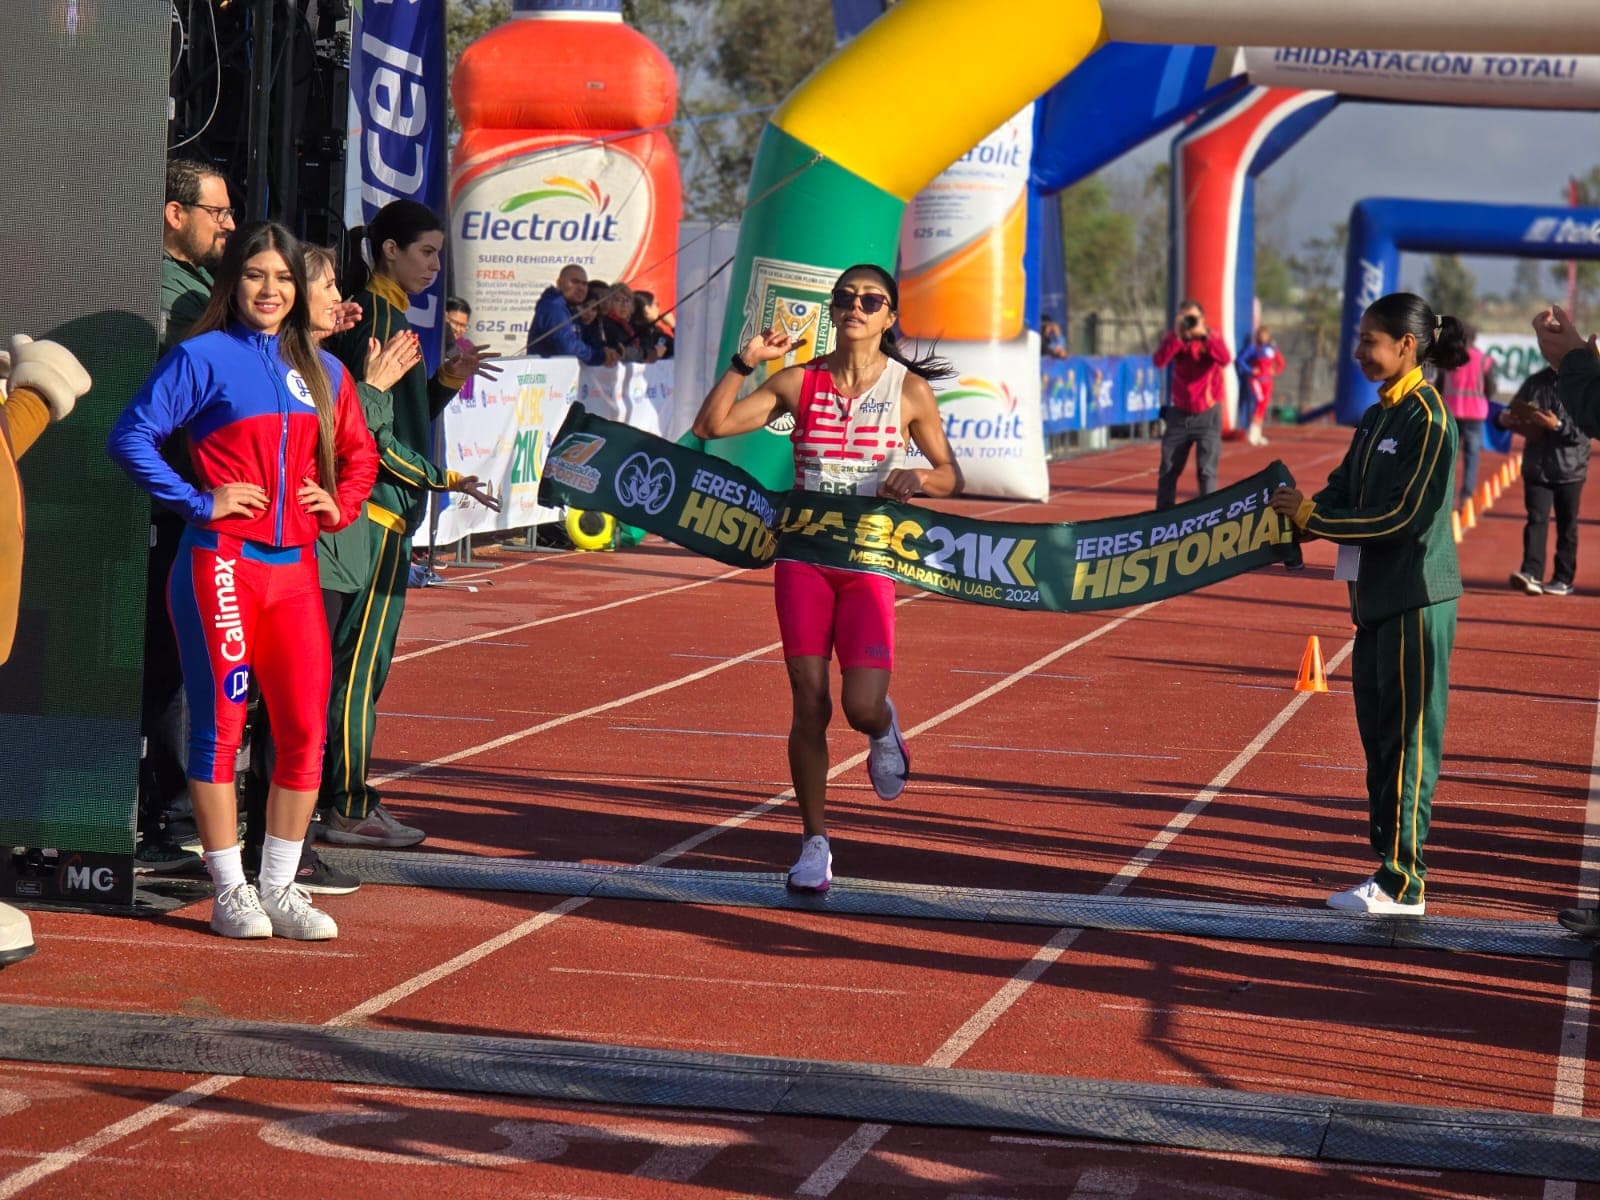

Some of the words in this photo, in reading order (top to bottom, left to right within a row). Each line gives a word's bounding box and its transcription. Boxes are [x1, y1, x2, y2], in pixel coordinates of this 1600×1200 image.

[1481, 56, 1578, 79] TOTAL!
[461, 210, 618, 242] Electrolit
[476, 269, 516, 280] FRESA
[478, 254, 513, 264] SUERO
[516, 255, 595, 265] REHIDRATANTE
[475, 321, 505, 332] 625
[763, 288, 776, 330] UNIVER
[941, 413, 1025, 439] trolit
[691, 468, 747, 505] ¡ERES
[678, 490, 778, 561] HISTO
[1075, 530, 1144, 561] ¡ERES
[1150, 507, 1224, 546] PARTE
[1226, 492, 1258, 520] DE
[1070, 505, 1294, 601] HISTORIA!
[897, 560, 961, 593] MARATÓN
[964, 581, 1003, 600] UABC
[1005, 588, 1040, 603] 2024
[214, 555, 247, 662] Calimax
